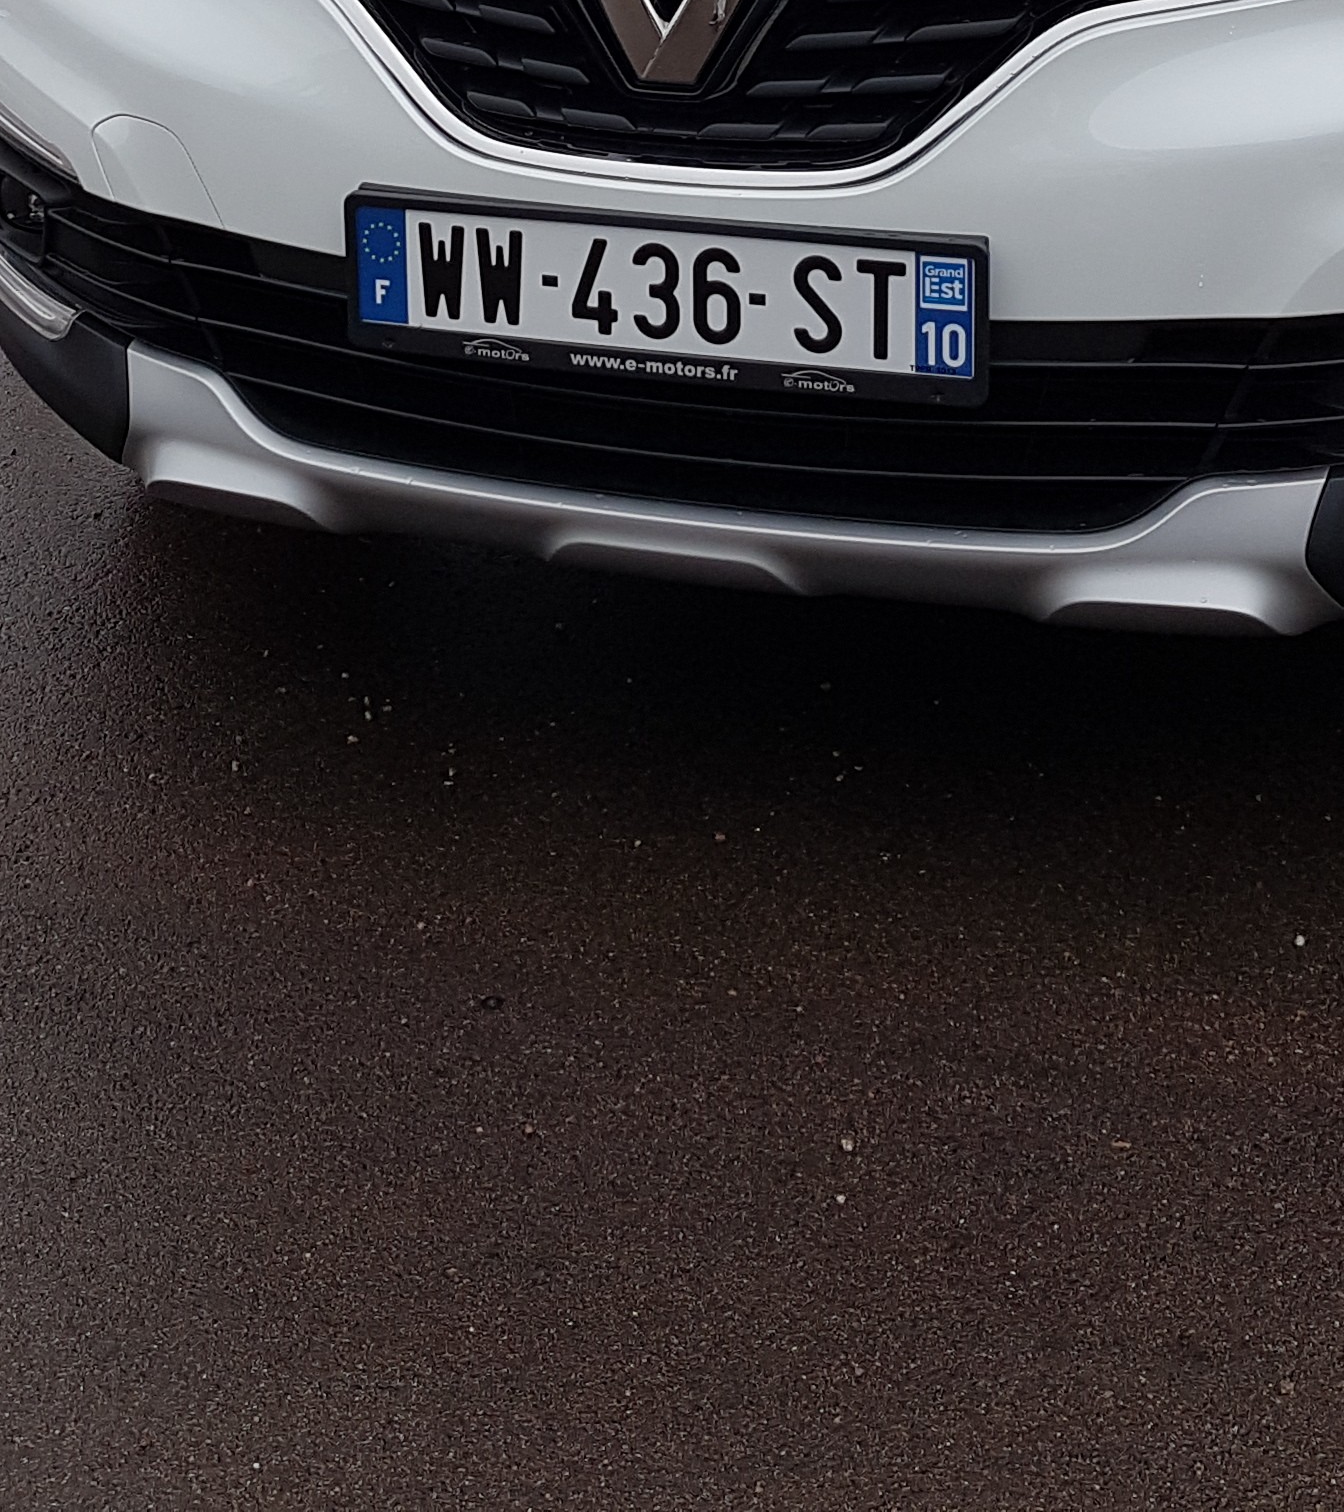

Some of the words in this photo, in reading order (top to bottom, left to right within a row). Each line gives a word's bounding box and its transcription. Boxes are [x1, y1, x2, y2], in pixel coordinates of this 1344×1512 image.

[924, 265, 964, 279] Grand
[375, 278, 391, 305] F
[924, 276, 964, 300] Est
[921, 321, 967, 368] 10
[569, 352, 739, 381] www.e-motors.fr
